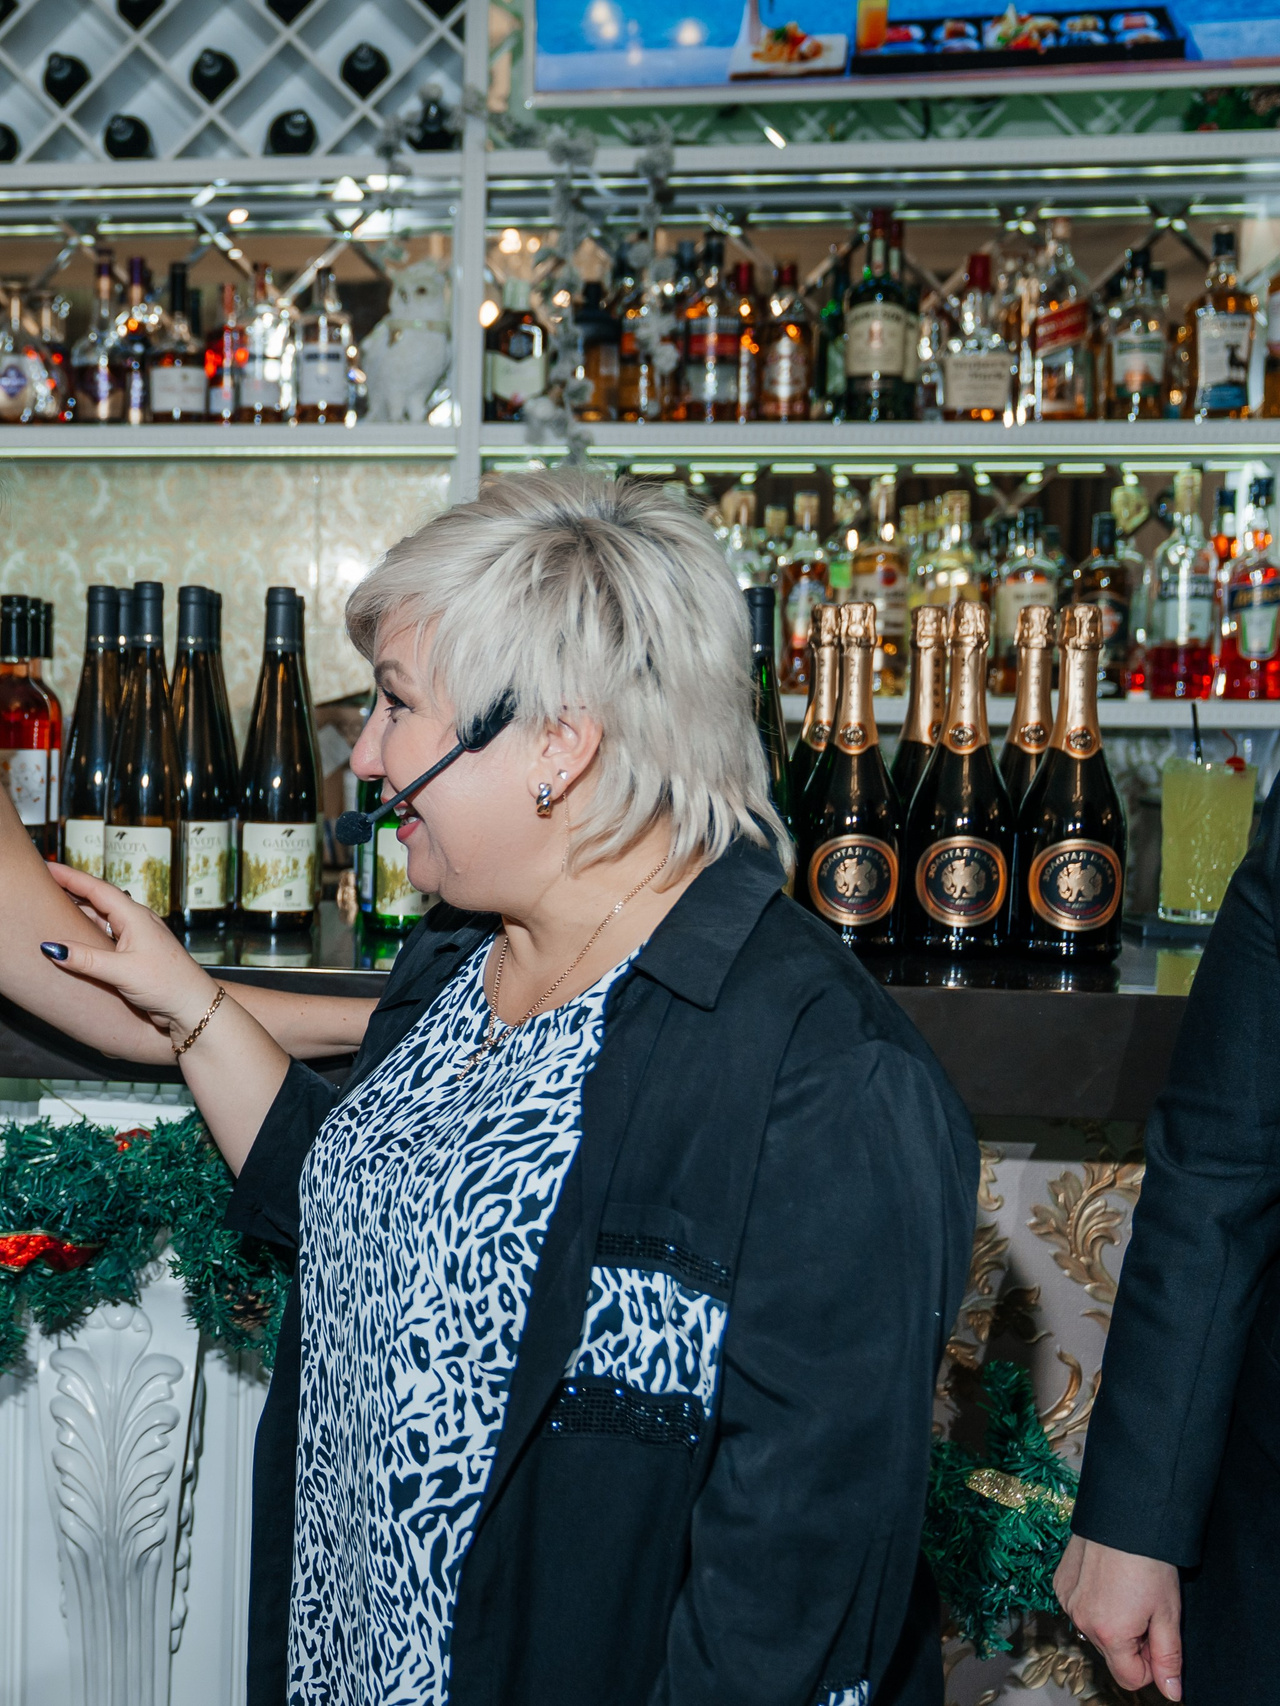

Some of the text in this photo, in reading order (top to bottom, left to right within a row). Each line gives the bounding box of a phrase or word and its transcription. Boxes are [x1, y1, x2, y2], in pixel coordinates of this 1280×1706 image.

[933, 657, 941, 709] КРЫМ
[263, 838, 310, 848] GAIVOTA
[820, 847, 862, 877] ЗОЛОТАЯ
[928, 848, 970, 879] ЗОЛОТАЯ
[1042, 851, 1087, 882] ЗОЛОТАЯ
